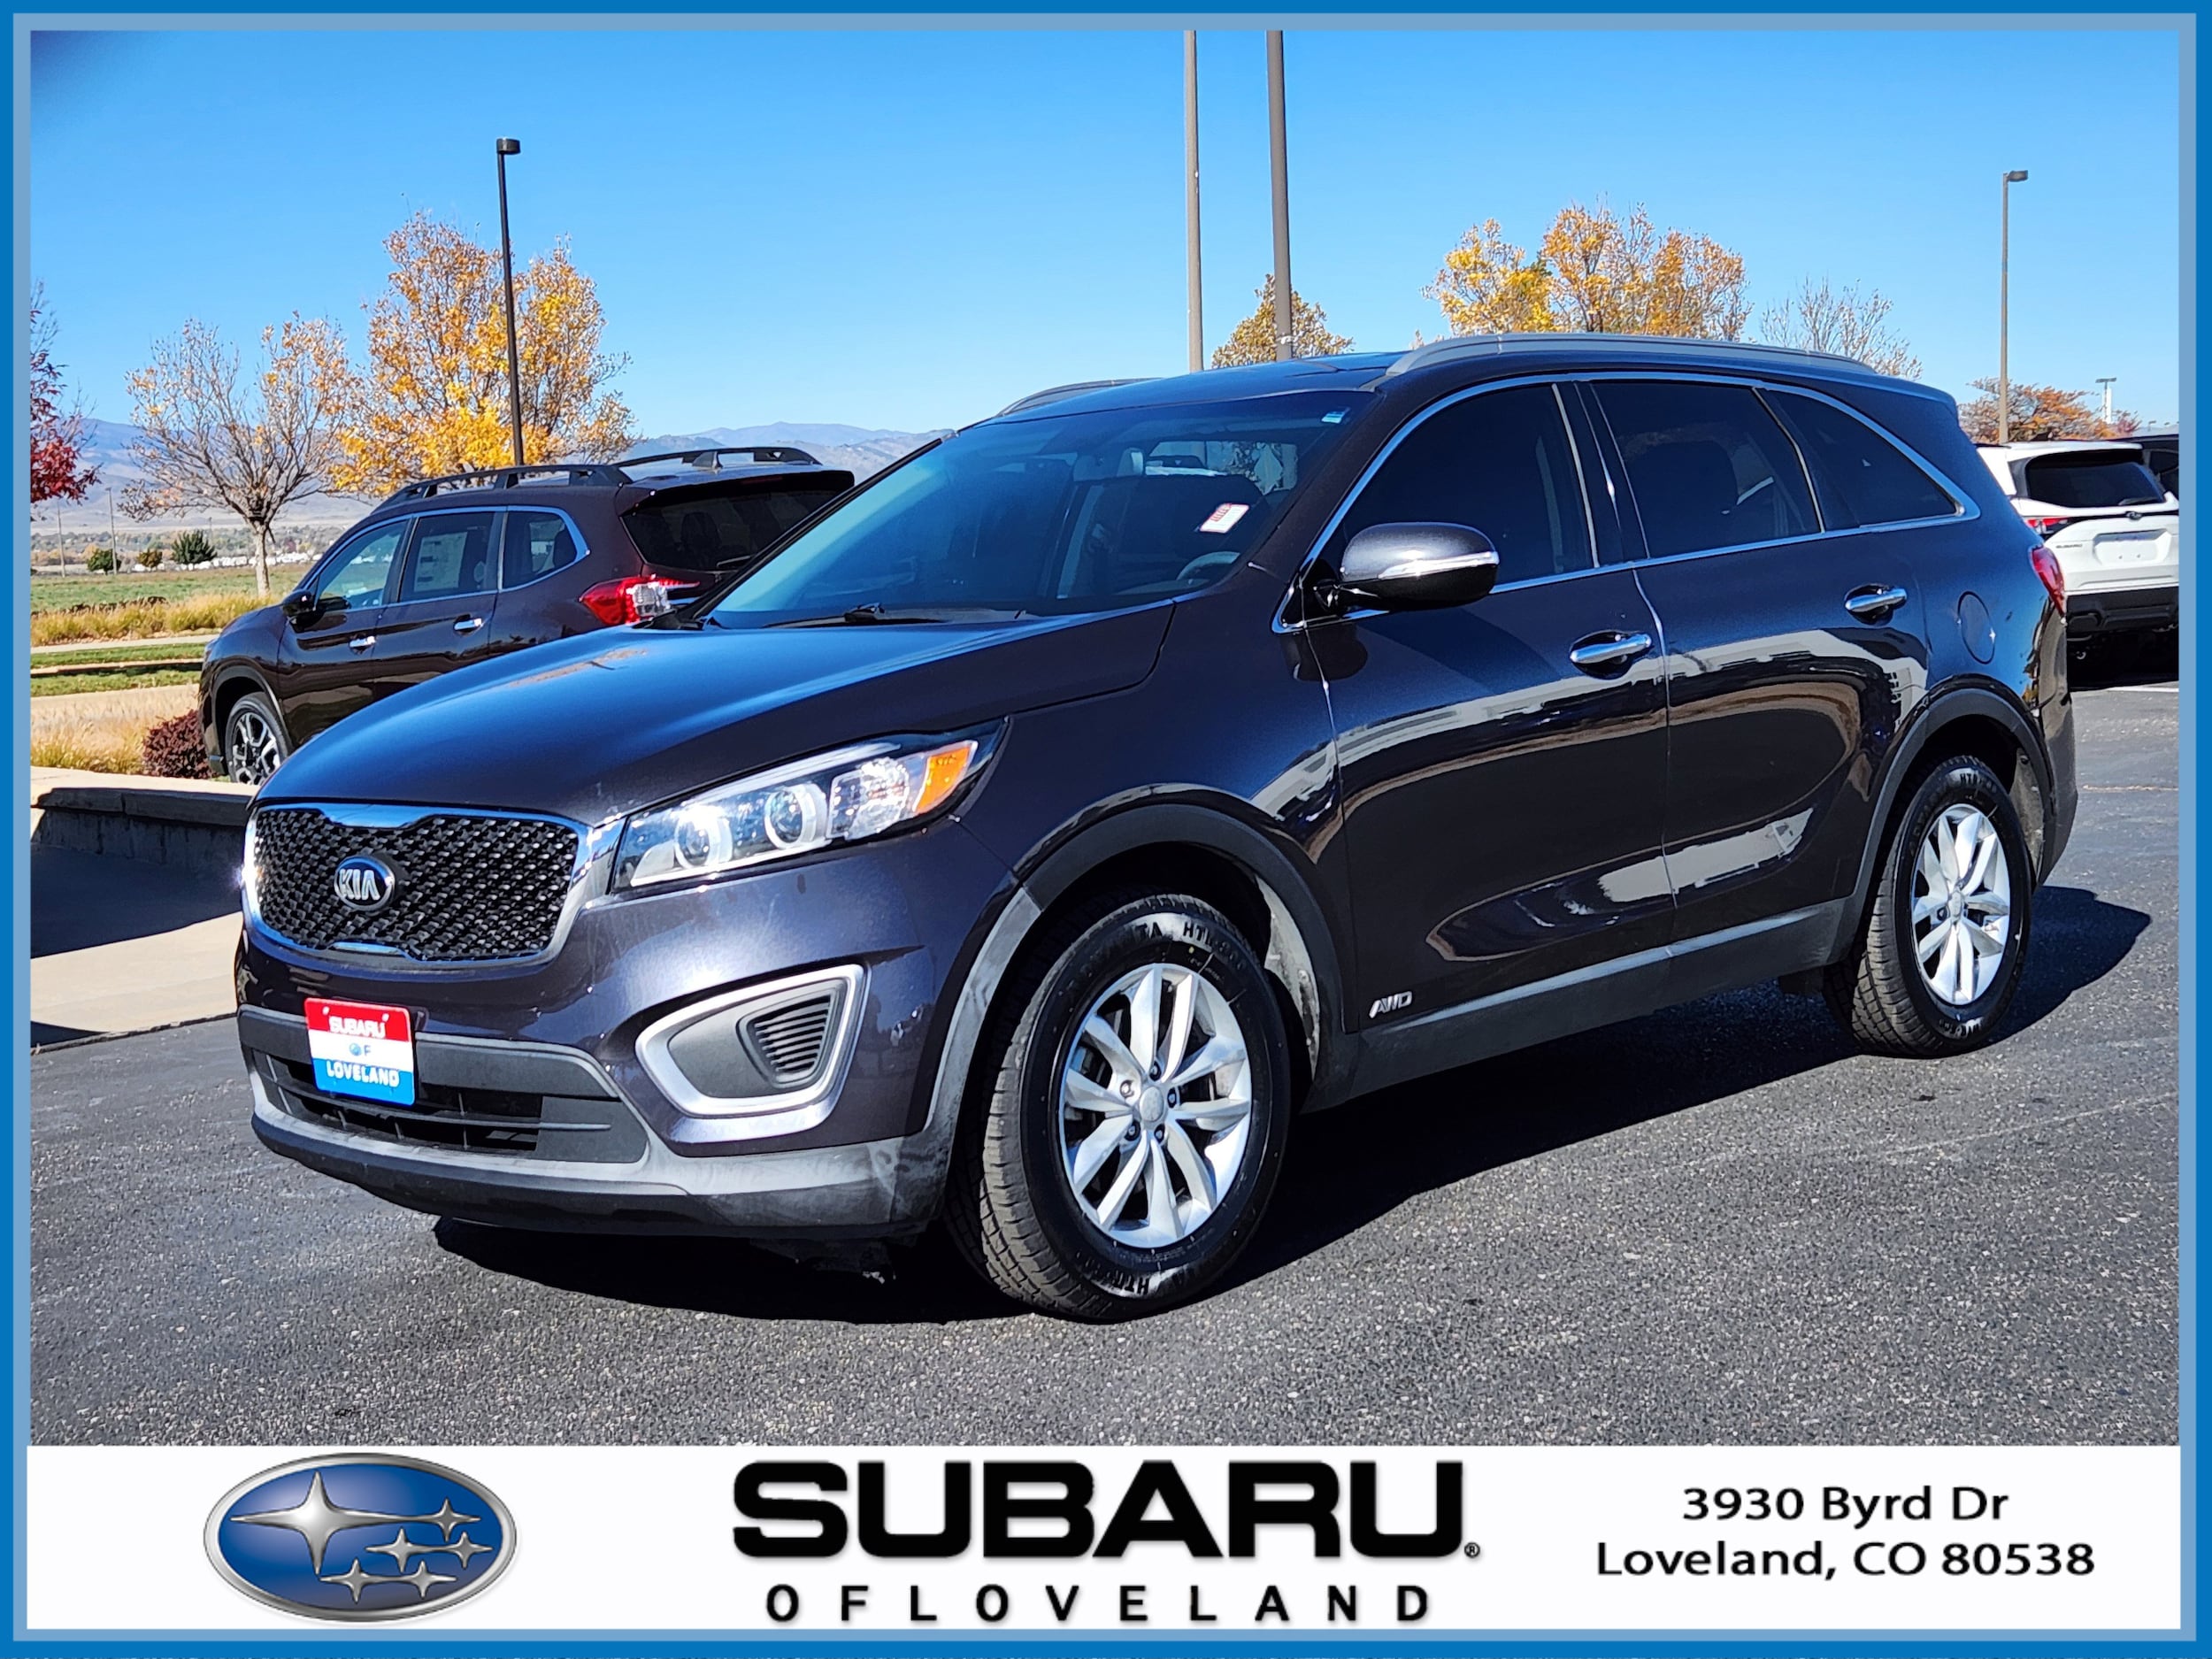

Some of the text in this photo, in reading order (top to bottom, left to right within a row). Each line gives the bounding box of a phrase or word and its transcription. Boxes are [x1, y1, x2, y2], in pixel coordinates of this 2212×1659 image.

[338, 868, 380, 901] KIA
[1368, 990, 1413, 1019] AWD
[328, 1015, 386, 1039] SUBARU
[326, 1060, 400, 1088] LOVELAND
